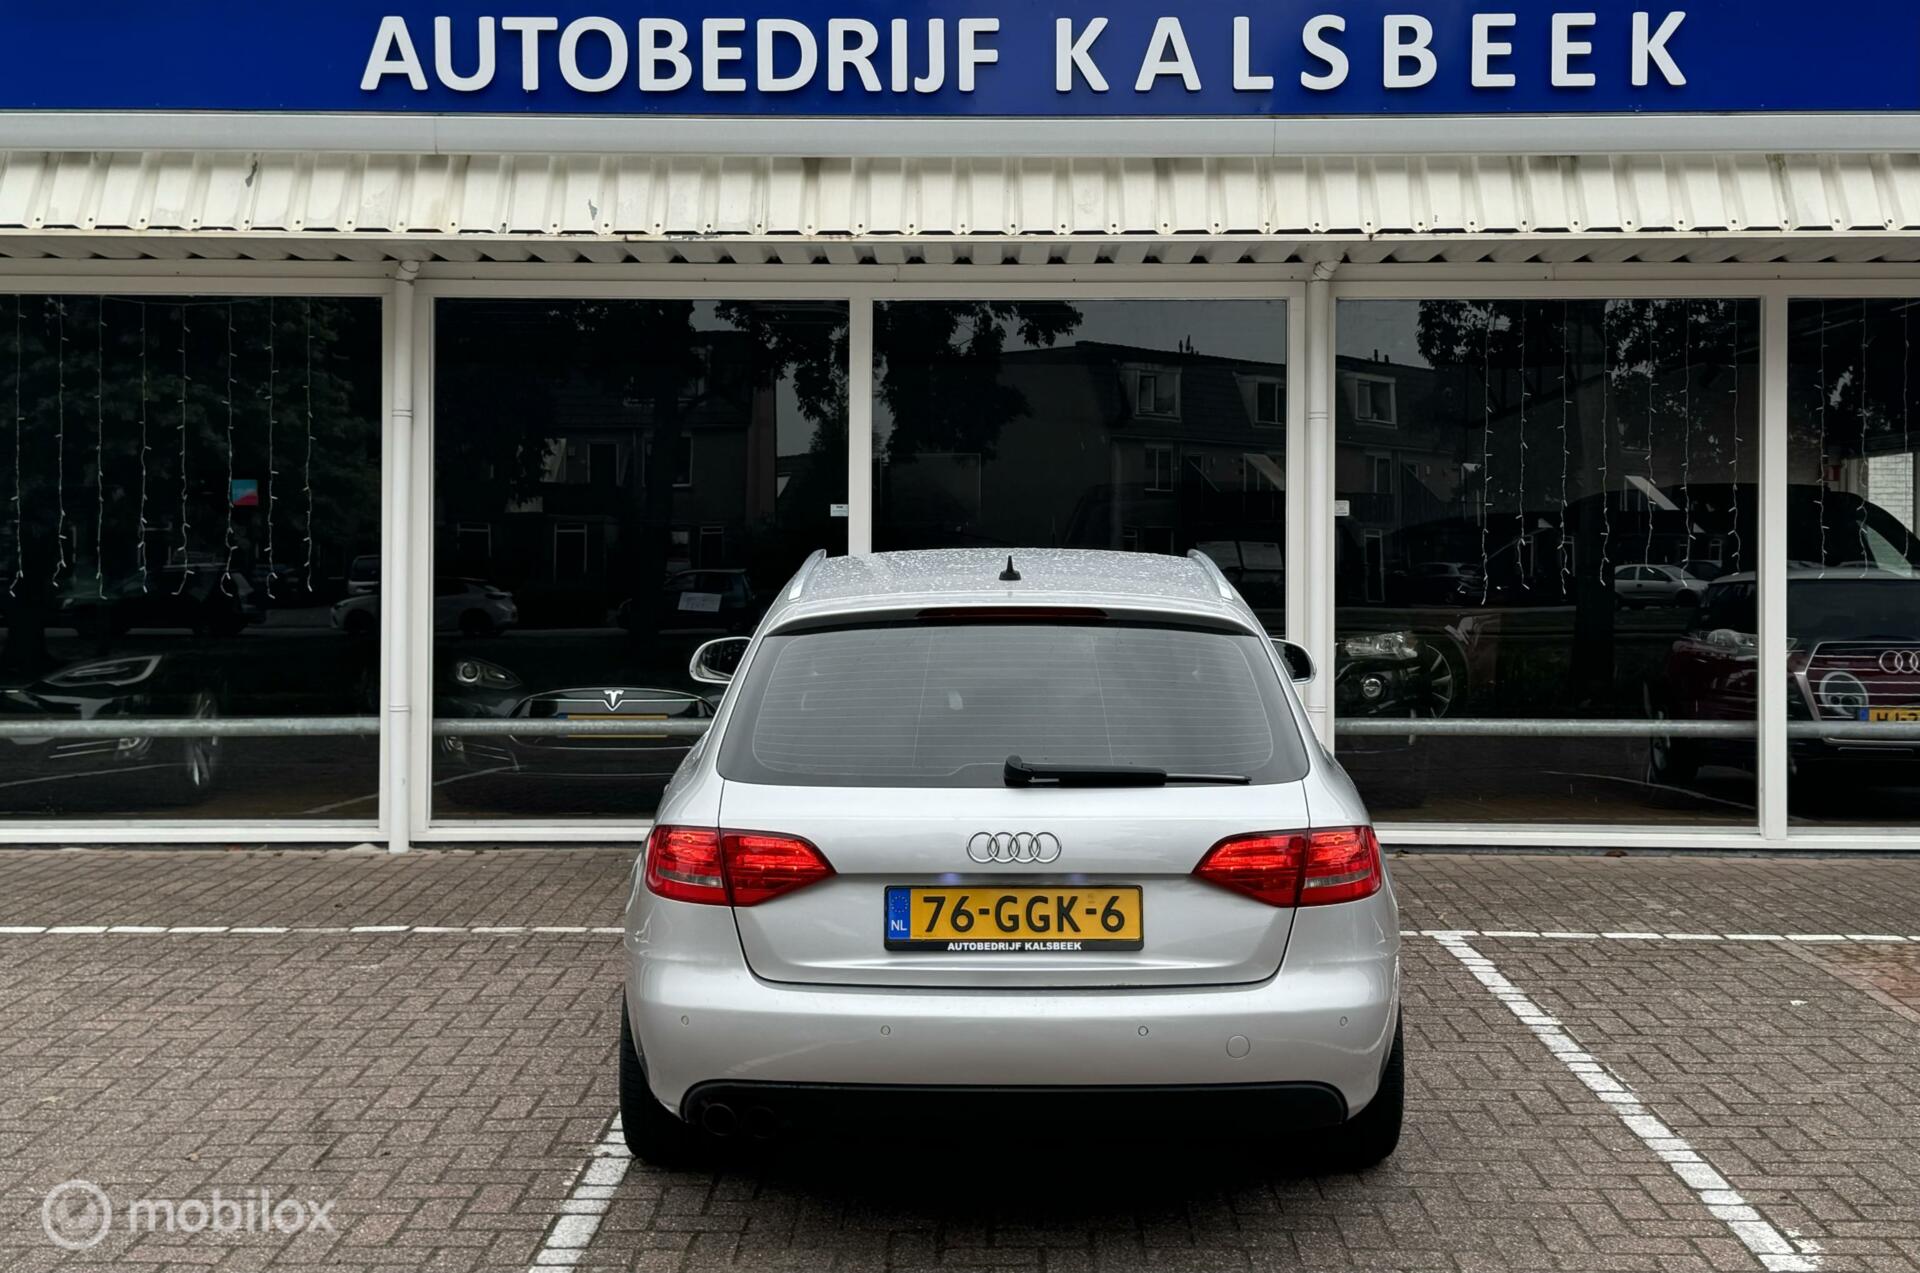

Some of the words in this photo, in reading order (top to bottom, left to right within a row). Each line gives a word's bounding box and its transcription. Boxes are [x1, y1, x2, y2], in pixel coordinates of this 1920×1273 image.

[360, 16, 1000, 93] AUTOBEDRIJF
[1055, 11, 1687, 92] KALSBEEK
[890, 919, 908, 931] NL
[923, 895, 1126, 933] 76-GGK-6
[947, 941, 1022, 951] AUTOBEDRIJF
[1024, 941, 1082, 951] KALSBEEK
